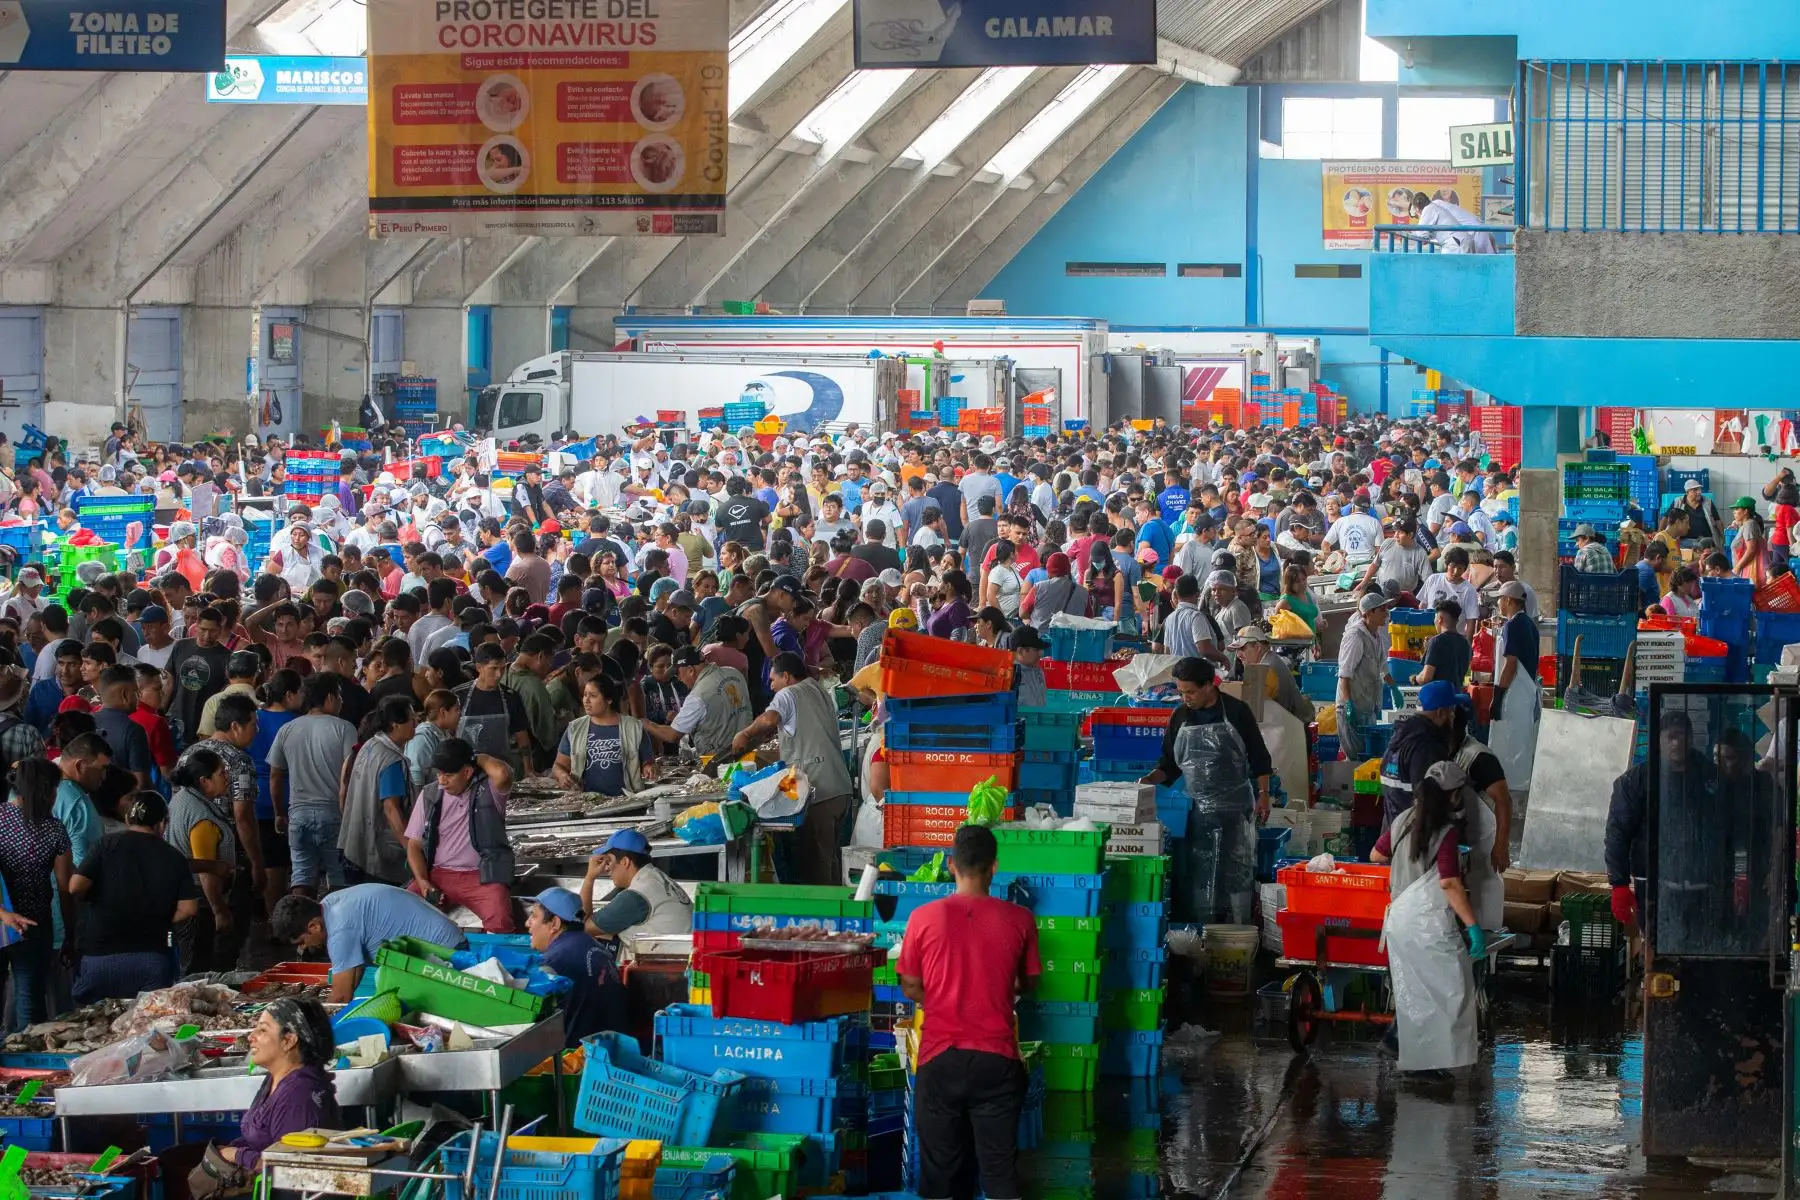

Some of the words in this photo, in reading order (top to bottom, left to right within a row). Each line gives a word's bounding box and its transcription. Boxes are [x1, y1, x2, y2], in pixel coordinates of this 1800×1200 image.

[607, 0, 659, 19] DEL
[69, 12, 138, 33] ZONA
[147, 13, 179, 33] DE
[985, 15, 1113, 38] CALAMAR
[438, 22, 657, 48] CORONAVIRUS
[77, 35, 171, 55] FILETEO
[465, 56, 493, 69] Sigue
[497, 57, 524, 67] estas
[277, 71, 363, 84] MARISCOS
[1406, 166, 1476, 174] CORONAVIRUS
[473, 198, 489, 206] más
[490, 197, 538, 206] información
[539, 197, 560, 205] llama
[601, 197, 615, 205] 113
[617, 197, 644, 205] SALUD
[414, 222, 448, 232] PRIMERO
[1350, 541, 1359, 550] 47
[923, 664, 952, 678] ROCIO
[926, 754, 955, 763] ROCIO
[959, 754, 975, 763] P.C.
[925, 807, 955, 817] ROCIO
[925, 819, 954, 829] ROCIO
[924, 832, 953, 842] ROCIO
[1114, 828, 1144, 836] POINT
[1114, 845, 1144, 853] POINT
[1314, 875, 1338, 884] SANTY
[1078, 919, 1089, 930] M
[1074, 962, 1086, 973] M
[422, 964, 497, 997] PAMELA
[1140, 991, 1151, 1002] M
[713, 1023, 783, 1037] LACHIRA
[713, 1044, 784, 1061] LACHIRA
[1072, 1046, 1083, 1057] M
